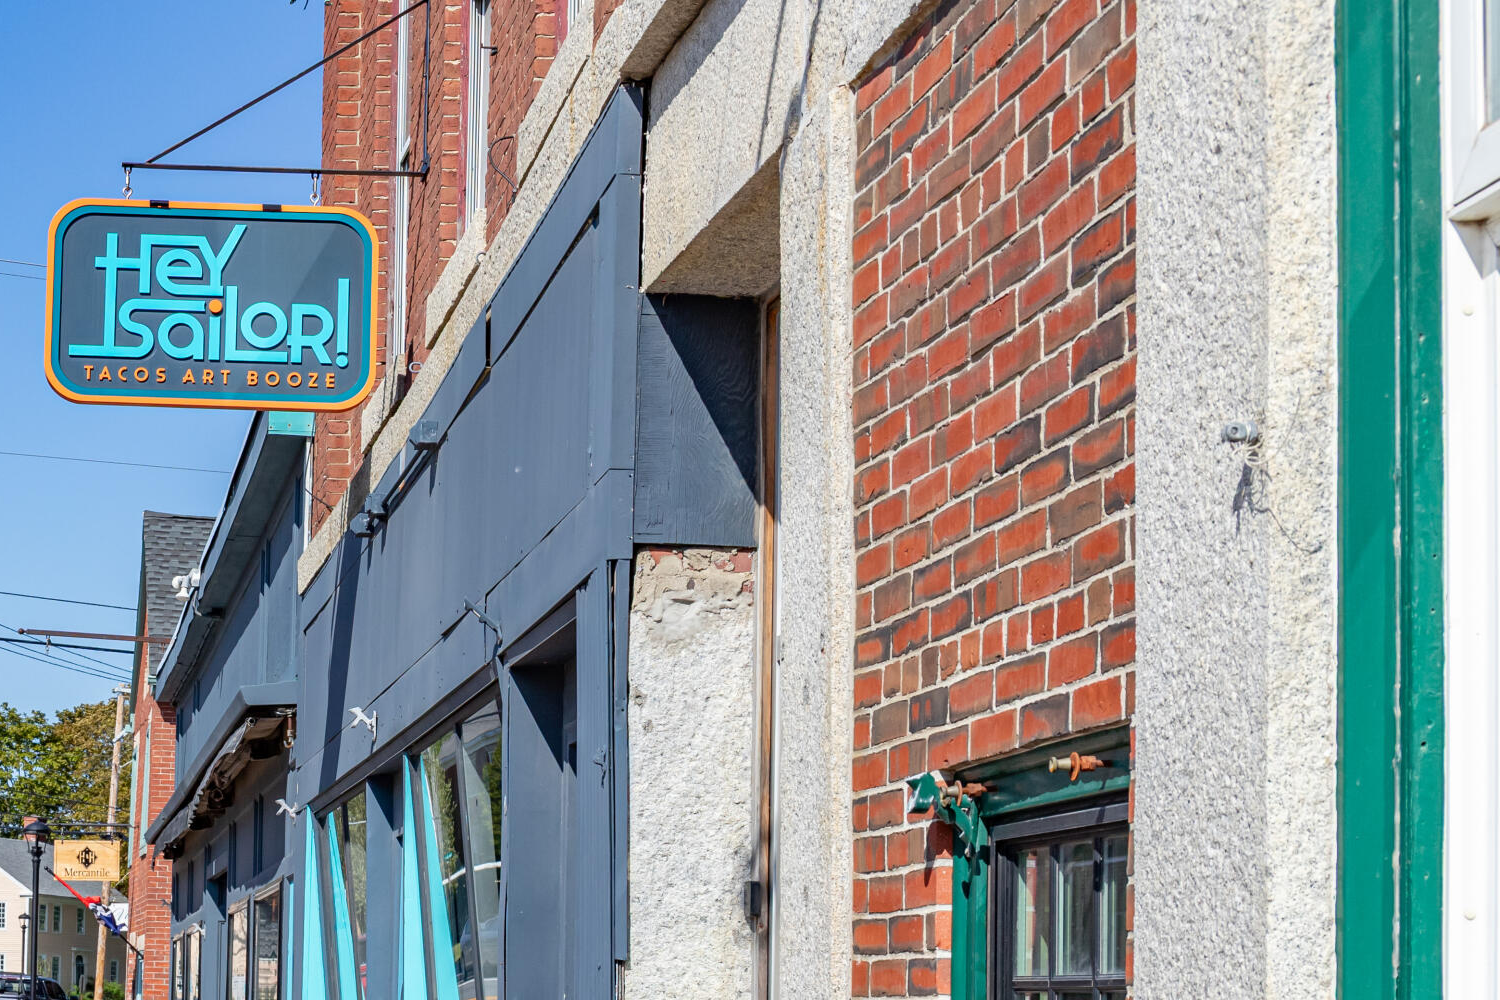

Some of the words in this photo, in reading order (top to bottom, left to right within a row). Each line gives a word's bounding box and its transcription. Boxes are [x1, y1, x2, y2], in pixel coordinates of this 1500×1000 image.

[83, 364, 167, 383] TACOS
[181, 368, 231, 385] ART
[246, 370, 336, 389] BOOZE
[64, 867, 110, 877] Mercantile
